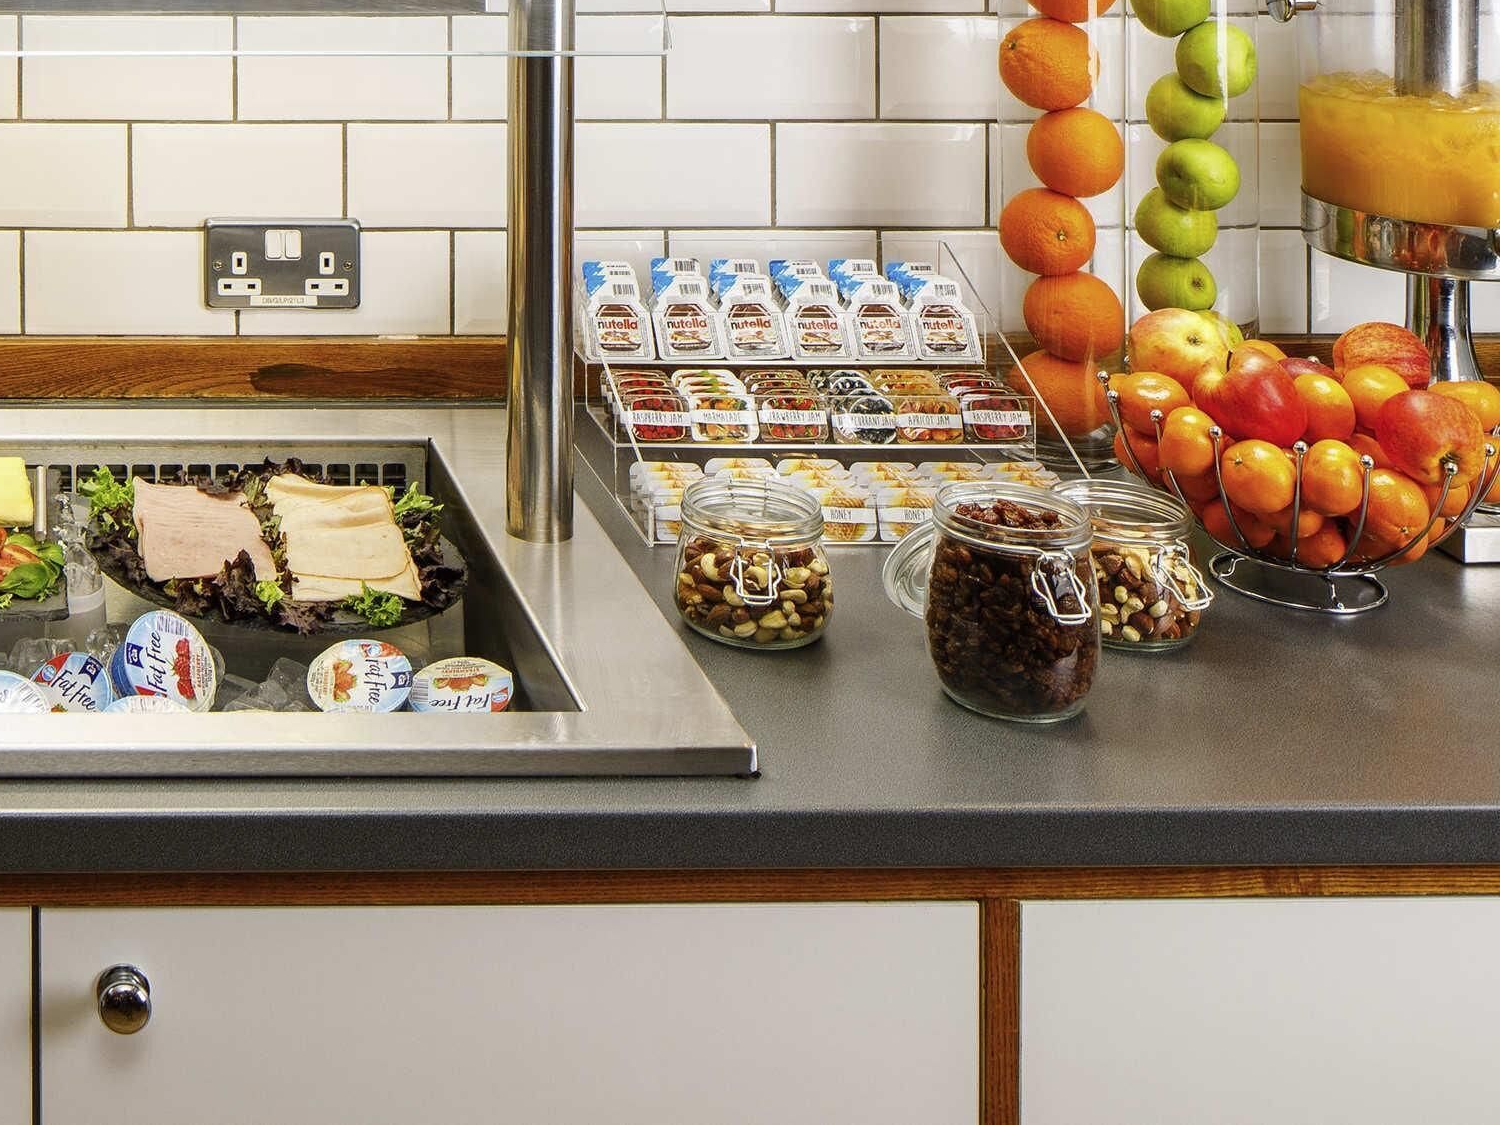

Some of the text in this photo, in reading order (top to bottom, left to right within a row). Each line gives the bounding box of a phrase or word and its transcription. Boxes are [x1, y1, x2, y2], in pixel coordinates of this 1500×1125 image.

[598, 318, 638, 330] nutella
[667, 317, 707, 329] nutella
[730, 318, 771, 330] nutella
[798, 319, 838, 330] nutella
[860, 319, 900, 329] nutella
[923, 319, 963, 330] nutella
[633, 412, 683, 424] RASPBERRY JAM
[703, 412, 741, 421] MARMALADE
[908, 415, 950, 425] APRICOT JAM
[972, 411, 1022, 423] RASPBERRY JAM
[830, 509, 852, 520] HONEY
[904, 509, 926, 520] HONEY
[145, 630, 168, 692] Fat Free
[364, 659, 389, 705] Fat Free
[50, 669, 75, 697] Fat
[68, 684, 96, 712] Free
[429, 694, 490, 711] Fat Free
